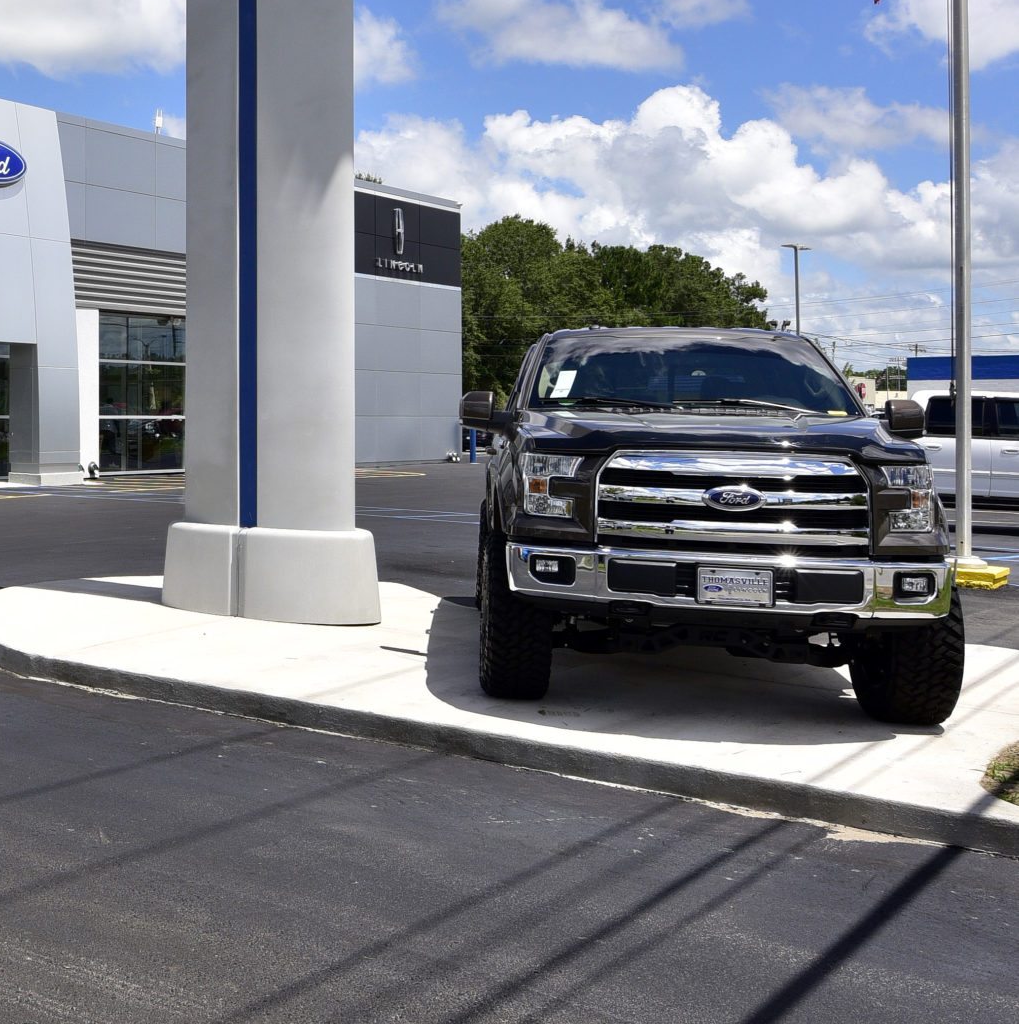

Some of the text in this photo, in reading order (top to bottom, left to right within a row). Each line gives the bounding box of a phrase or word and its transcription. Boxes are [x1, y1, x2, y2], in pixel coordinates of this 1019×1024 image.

[376, 257, 424, 274] LINCOLN
[720, 491, 751, 505] Ford
[702, 576, 769, 586] THOMASVILLE
